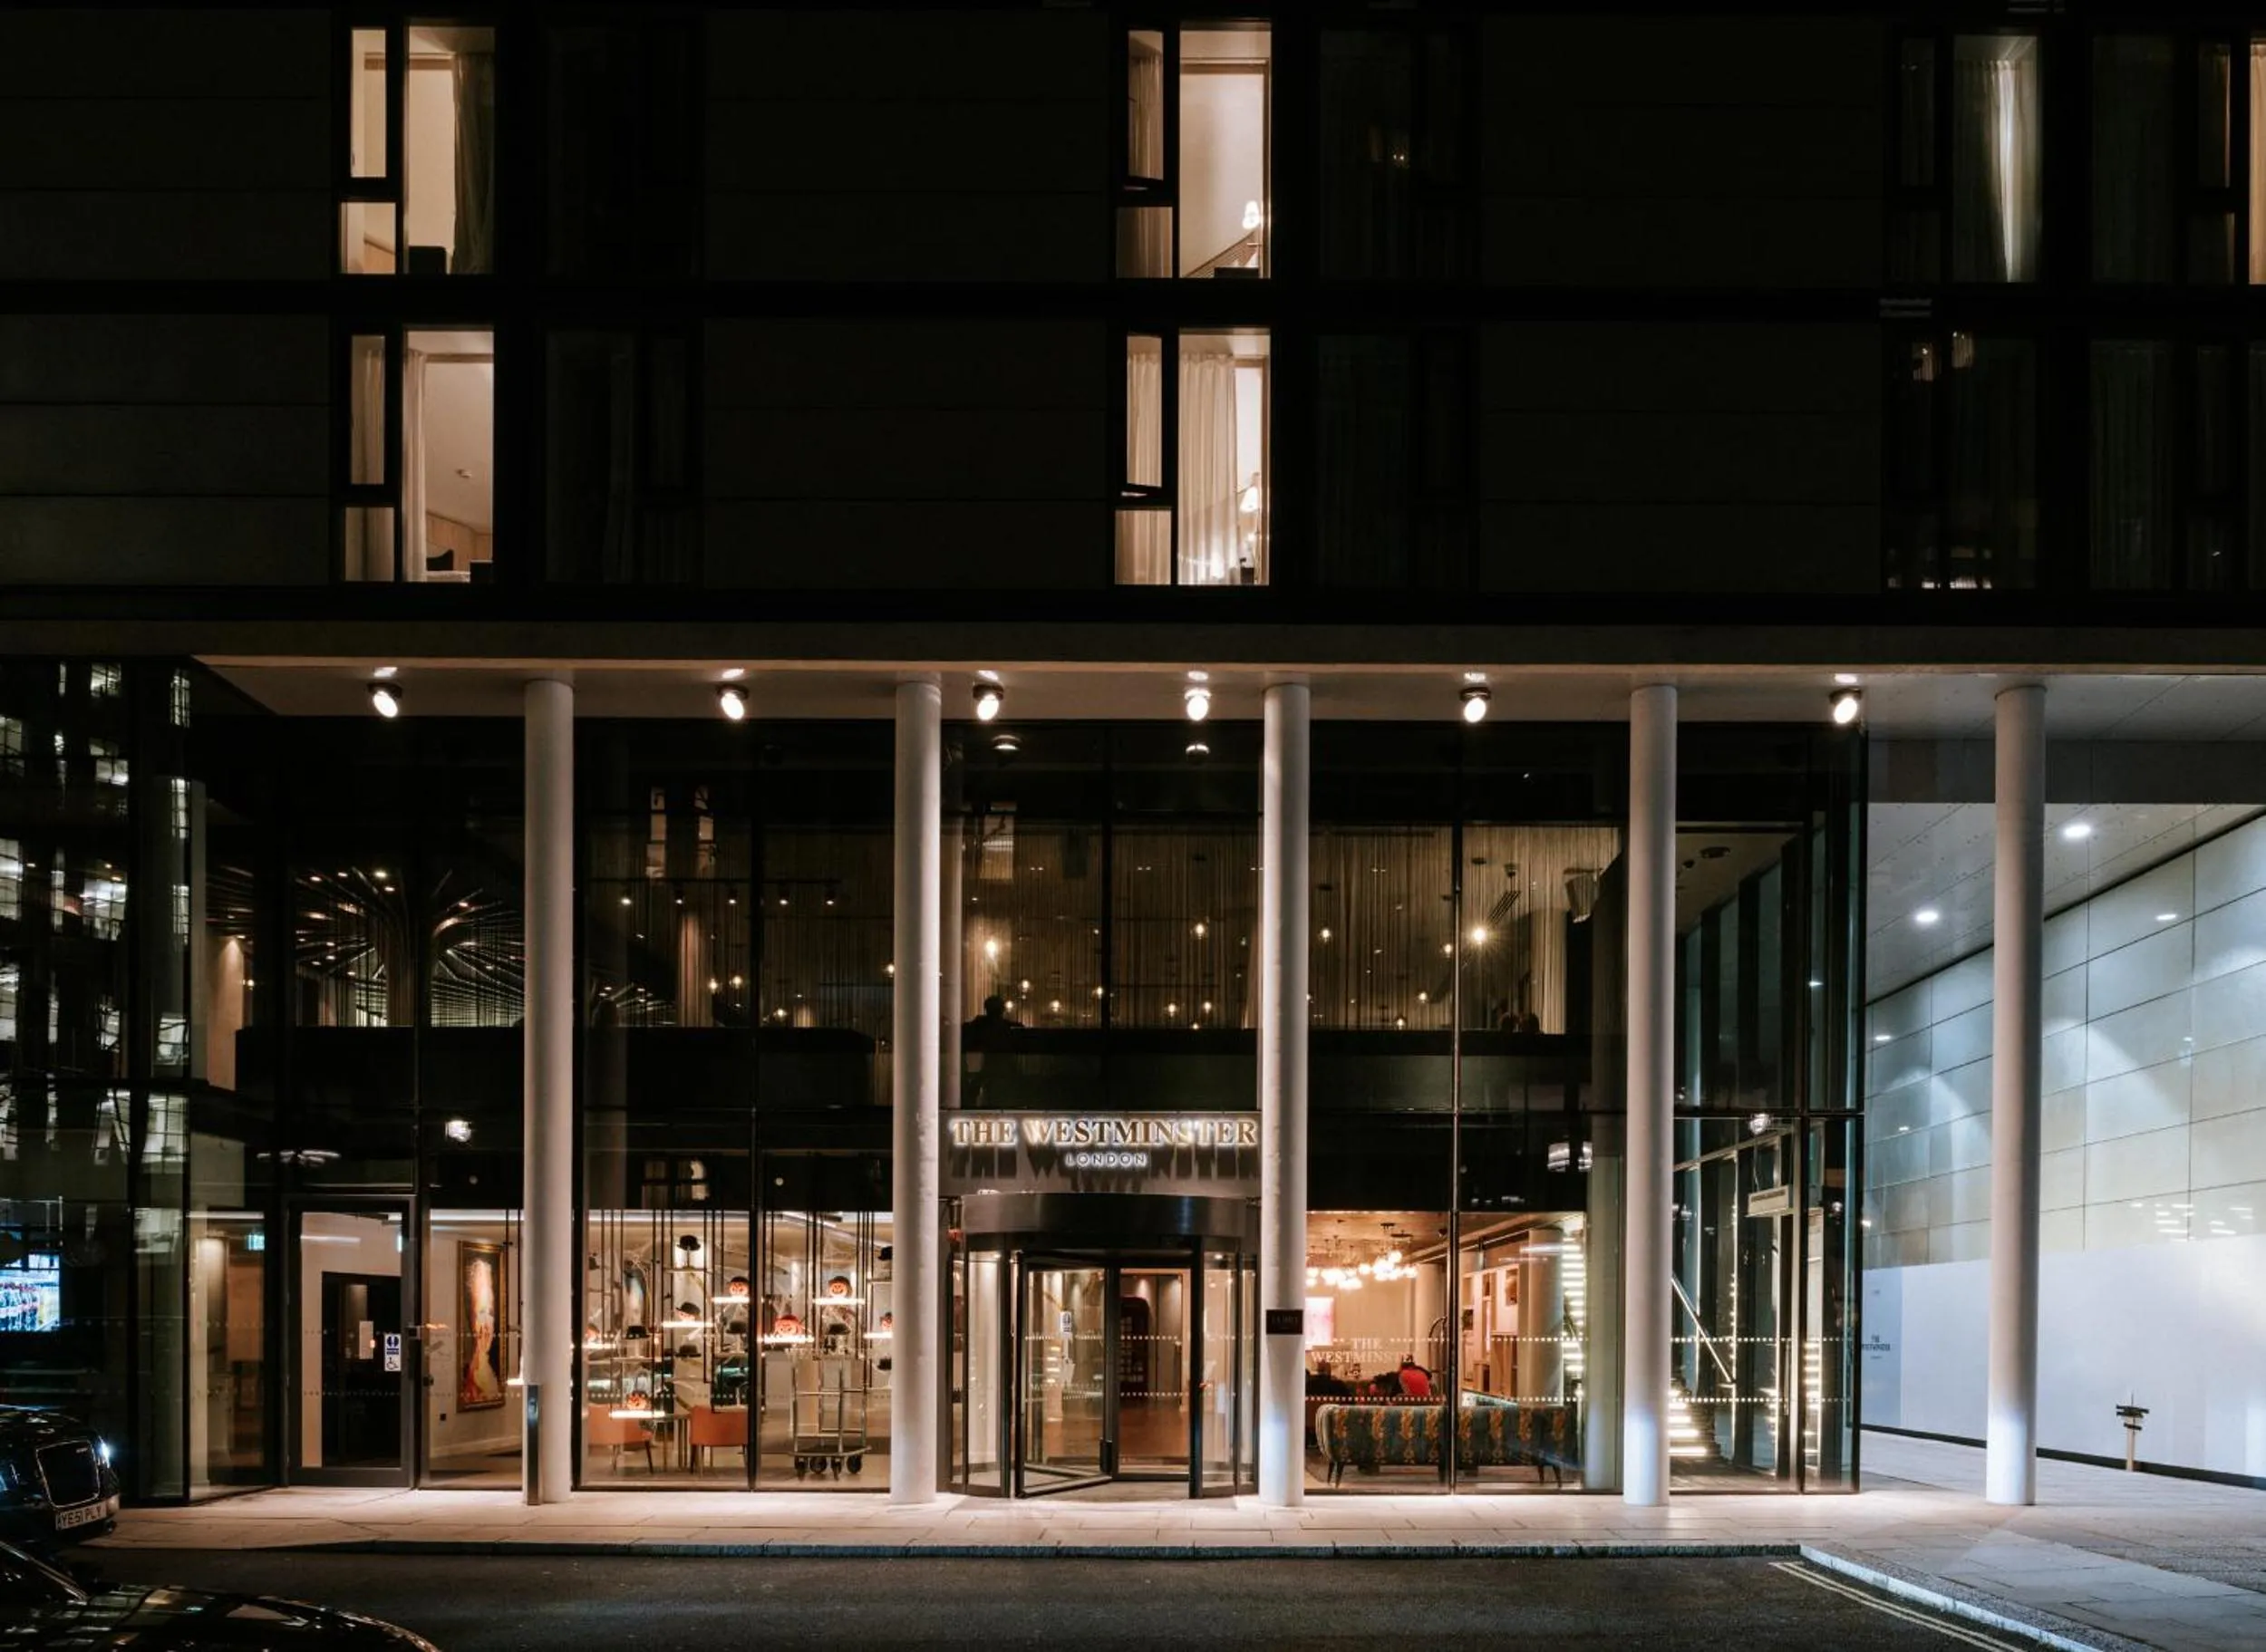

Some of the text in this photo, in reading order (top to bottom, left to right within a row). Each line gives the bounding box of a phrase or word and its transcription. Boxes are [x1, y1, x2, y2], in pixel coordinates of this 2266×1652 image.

[953, 1119, 1257, 1146] THE WESTMINSTER
[1066, 1153, 1147, 1167] LONDON
[1353, 1338, 1383, 1349] THE
[1311, 1350, 1419, 1363] WESTMINSTE
